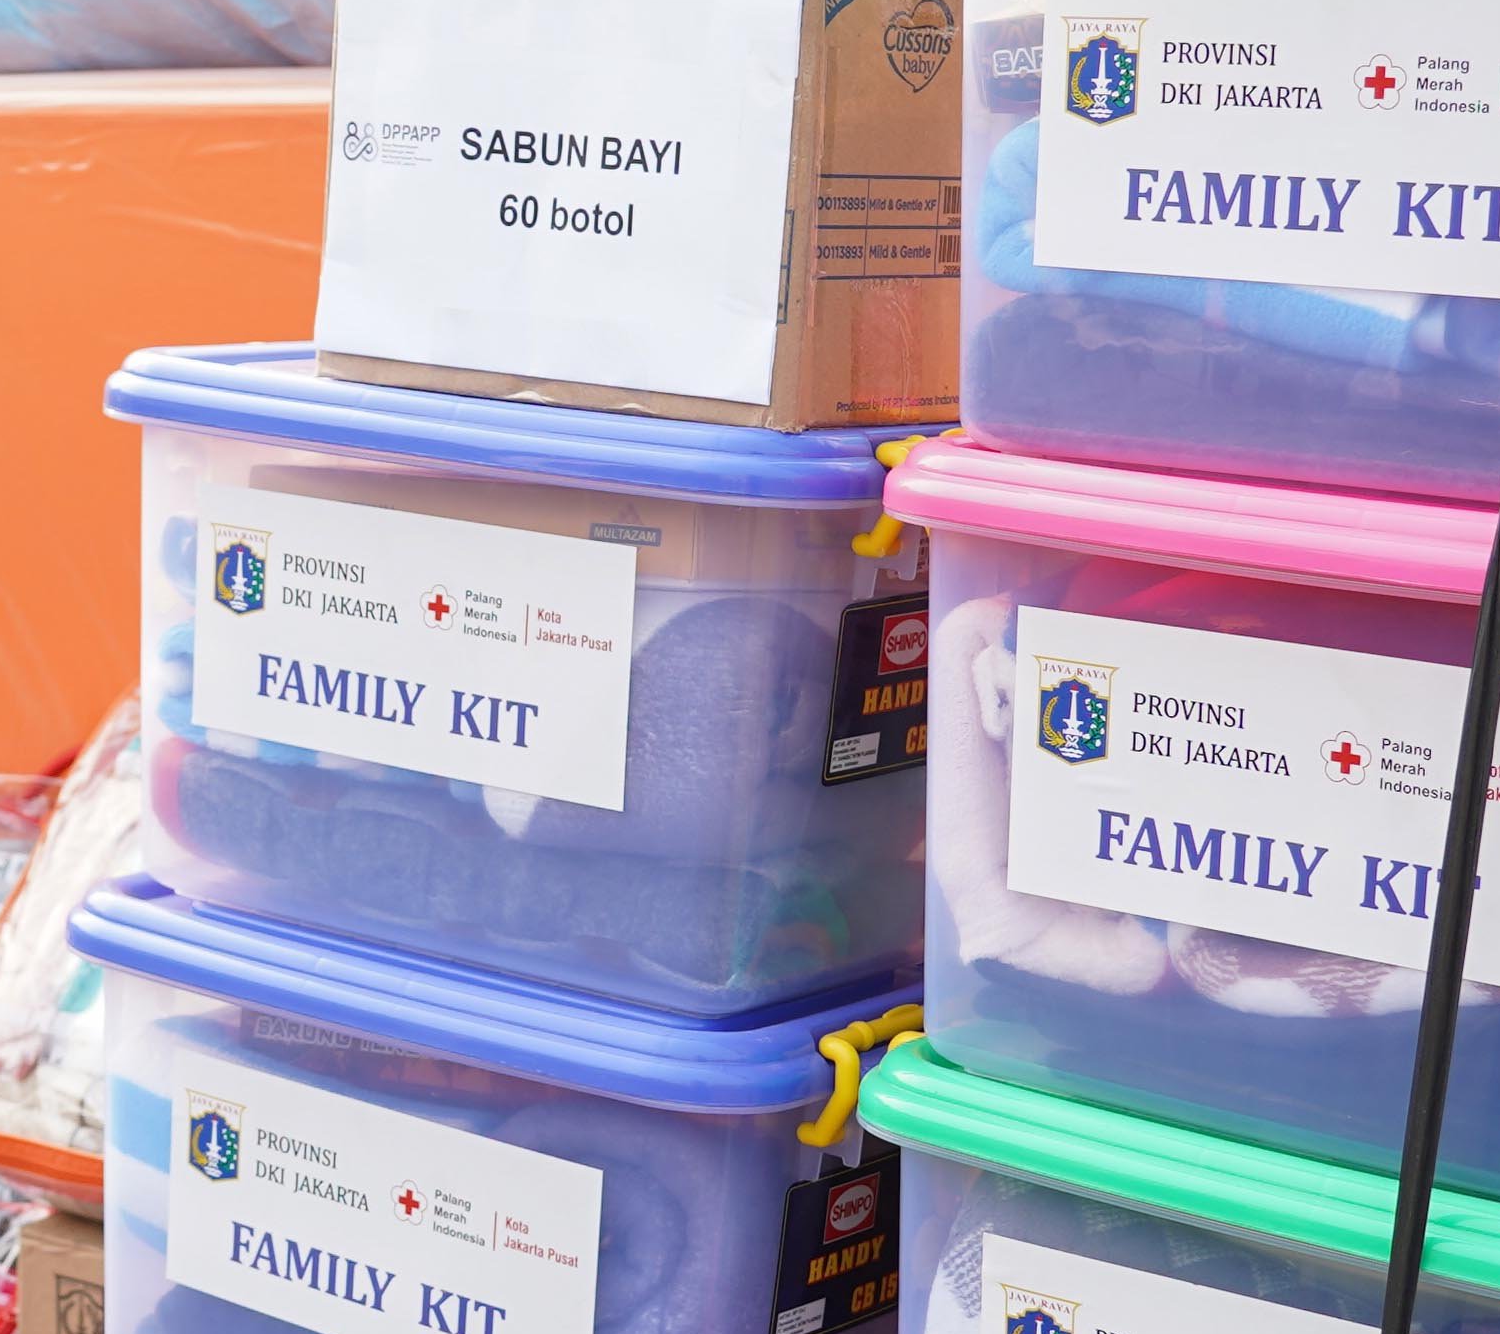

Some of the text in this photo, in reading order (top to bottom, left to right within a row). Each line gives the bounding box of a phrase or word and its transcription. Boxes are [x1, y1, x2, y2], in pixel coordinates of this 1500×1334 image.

[884, 24, 952, 54] Cussons
[1070, 22, 1138, 34] JAYA RAYA
[1162, 41, 1276, 67] PROVINSI
[1418, 56, 1470, 73] Palang
[903, 55, 935, 79] baby
[1160, 83, 1322, 111] DKI JAKARTA
[1416, 77, 1463, 92] Merah
[1414, 98, 1490, 115] Indonesia
[383, 124, 440, 142] DPPAPP
[460, 127, 588, 169] SABUN
[601, 135, 682, 175] BAYI
[869, 199, 936, 211] Mild & Gentle XF
[1124, 168, 1360, 233] FAMILY
[500, 194, 634, 237] 60 botol
[869, 246, 931, 259] Mild & Gentle
[594, 525, 657, 543] MULTAZAM
[283, 553, 365, 584] PROVINSI
[282, 586, 399, 624] DKI JAKARTA
[465, 590, 503, 607] Palang
[464, 607, 498, 623] Merah
[537, 608, 562, 624] Kota
[463, 624, 517, 644] Indonesia
[536, 627, 612, 653] Jakarta Pusat
[887, 631, 926, 653] SHINPO
[1075, 668, 1108, 681] RAYA
[257, 653, 538, 748] FAMILY KIT
[1133, 691, 1245, 730] PROVINSI
[1131, 731, 1291, 777] DKI JAKARTA
[1381, 737, 1432, 759] Palang
[1380, 758, 1426, 777] Merah
[1379, 778, 1452, 801] Indonesia
[1095, 808, 1328, 897] FAMILY
[257, 1128, 337, 1170] PROVINSI
[255, 1159, 370, 1212] DKI JAKARTA
[434, 1189, 471, 1212] Palang
[833, 1195, 872, 1221] SHINPO
[434, 1205, 467, 1225] Merah
[505, 1216, 529, 1235] Kota
[433, 1221, 486, 1248] Indonesia
[503, 1235, 579, 1268] Jakarta Pusat
[808, 1235, 885, 1285] HANDY
[230, 1220, 396, 1313] FAMILY
[852, 1272, 898, 1313] CB 15
